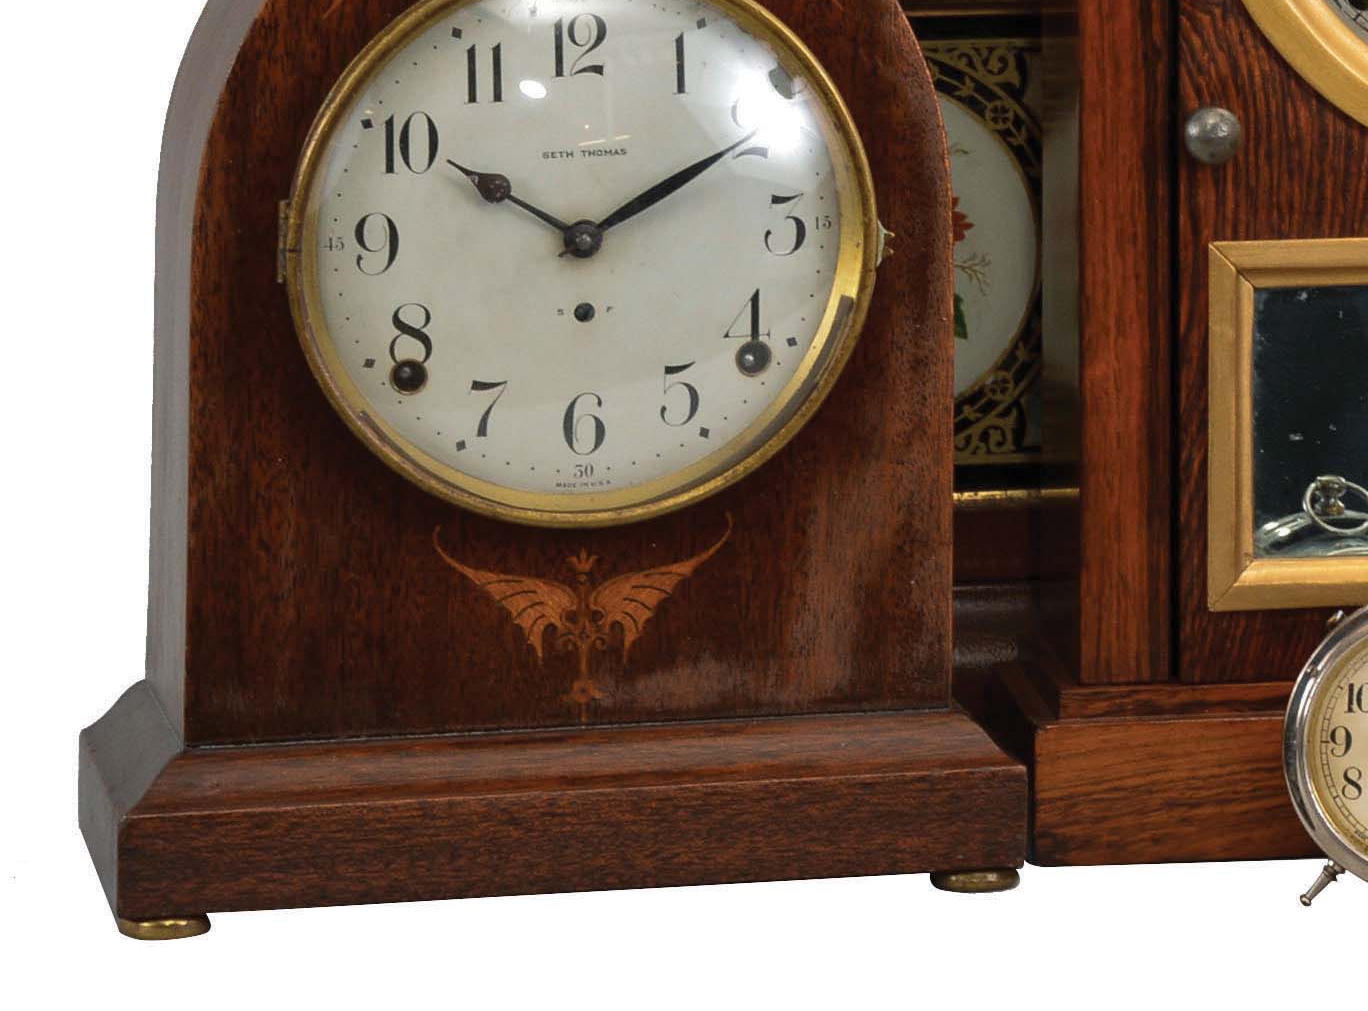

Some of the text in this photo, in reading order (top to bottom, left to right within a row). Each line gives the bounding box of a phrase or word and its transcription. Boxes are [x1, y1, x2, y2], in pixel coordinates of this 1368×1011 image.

[464, 42, 503, 104] 11
[552, 13, 607, 77] 12
[672, 32, 686, 94] 1
[381, 111, 438, 174] 10
[542, 148, 627, 160] SETH THOMAS
[323, 237, 345, 251] 45
[355, 213, 399, 275] 9
[764, 193, 805, 256] 3
[813, 216, 832, 230] 15
[389, 303, 433, 366] 8
[723, 288, 770, 340] 4
[471, 380, 508, 437] 7
[563, 392, 606, 456] 6
[660, 361, 699, 427] 5
[1330, 726, 1352, 757] 9
[1342, 767, 1362, 800] 8
